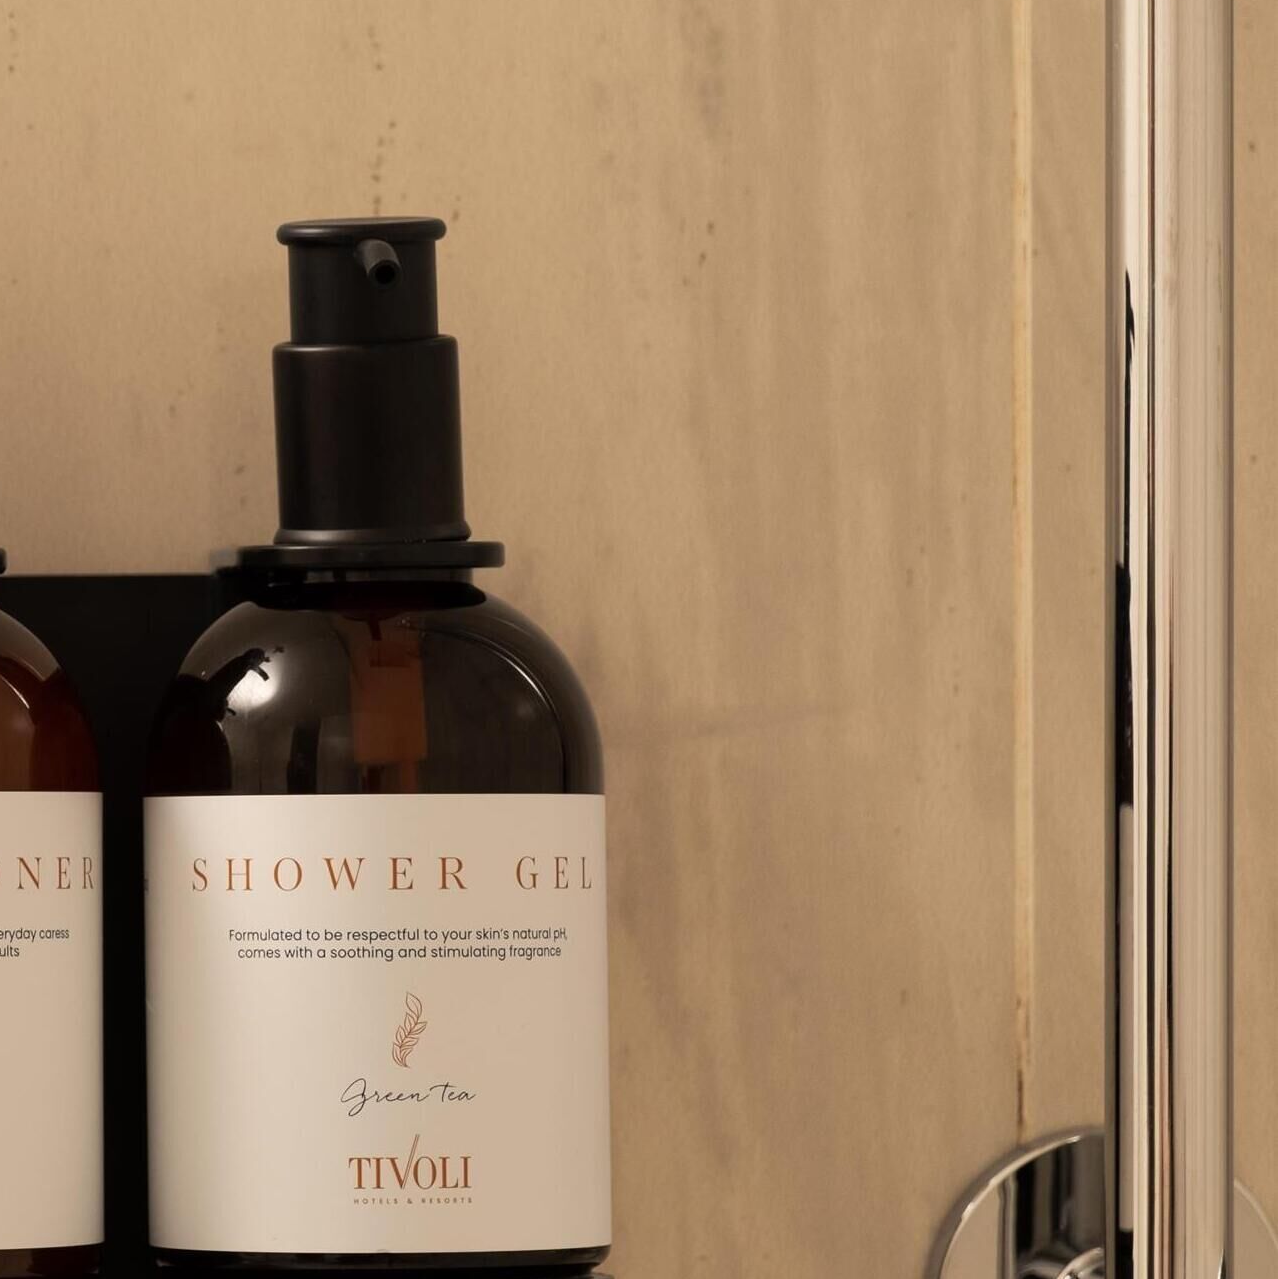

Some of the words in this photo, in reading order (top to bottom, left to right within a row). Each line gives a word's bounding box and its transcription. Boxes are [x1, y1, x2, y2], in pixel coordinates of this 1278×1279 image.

[192, 856, 468, 892] SHOWER
[515, 855, 592, 890] GEL
[38, 929, 70, 939] caress
[228, 929, 302, 941] Formulated
[305, 929, 321, 941] to
[323, 929, 343, 941] be
[346, 928, 420, 943] respectful
[422, 929, 439, 941] to
[441, 930, 472, 943] your
[511, 928, 552, 940] natural
[237, 947, 281, 959] comes
[283, 946, 314, 959] with
[316, 947, 327, 959] a
[330, 946, 394, 962] soothing
[397, 946, 427, 958] and
[430, 946, 507, 961] stimulating
[508, 945, 562, 961] fragrance
[341, 1078, 428, 1117] Green
[429, 1082, 476, 1104] Tea
[349, 1134, 471, 1190] TIVOLI
[353, 1197, 399, 1206] HOTELS
[420, 1196, 473, 1205] RESORTS
